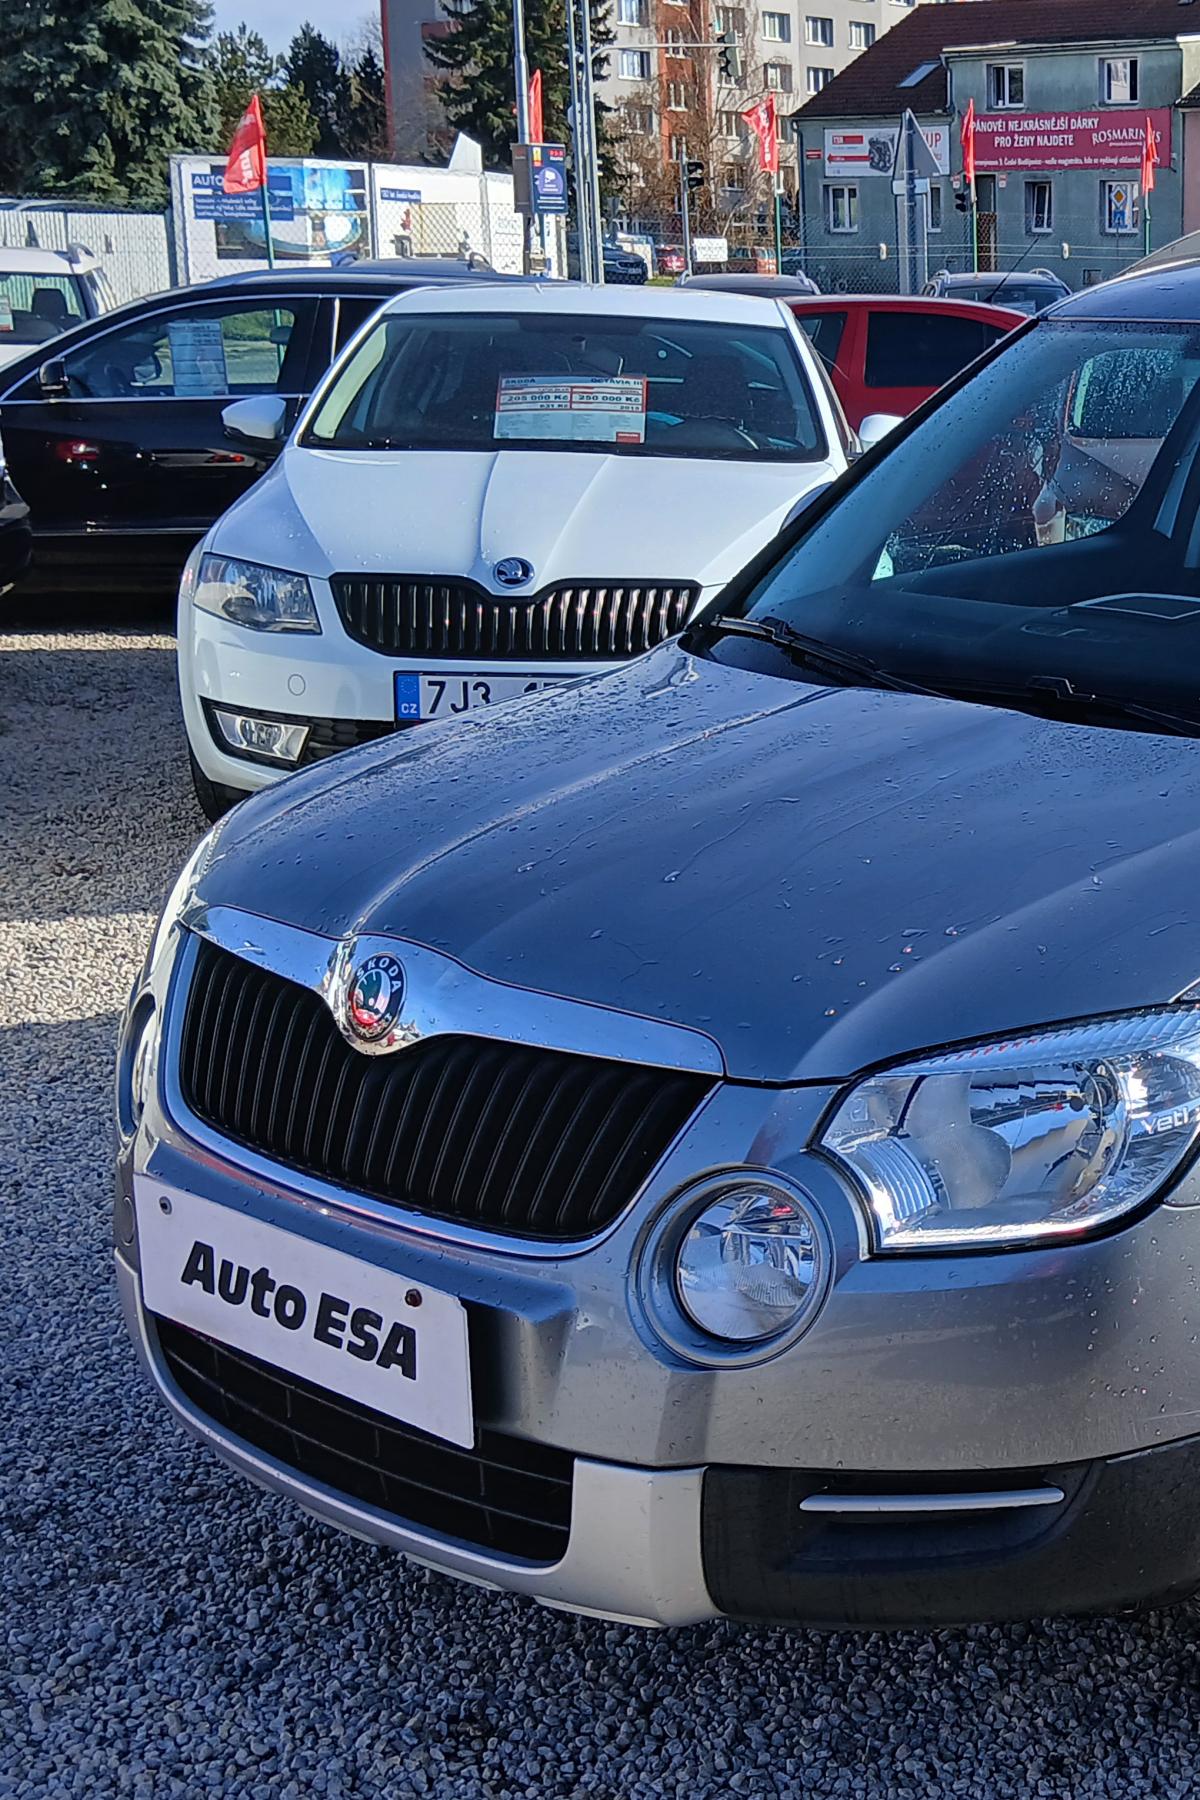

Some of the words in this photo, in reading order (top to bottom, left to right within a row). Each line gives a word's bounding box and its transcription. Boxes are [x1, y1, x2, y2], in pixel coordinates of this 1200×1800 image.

[1008, 116, 1068, 131] NEJKRÁSNĚJŠÍ
[1070, 116, 1099, 129] DÁRKY
[994, 136, 1012, 147] PRO
[1013, 133, 1035, 147] ŽENY
[1037, 134, 1074, 146] NAJDETE
[1092, 128, 1161, 146] ROSMARINS
[427, 681, 490, 714] 7J3
[401, 703, 418, 714] CZ
[181, 1240, 306, 1331] Auto
[313, 1292, 417, 1381] ESA
